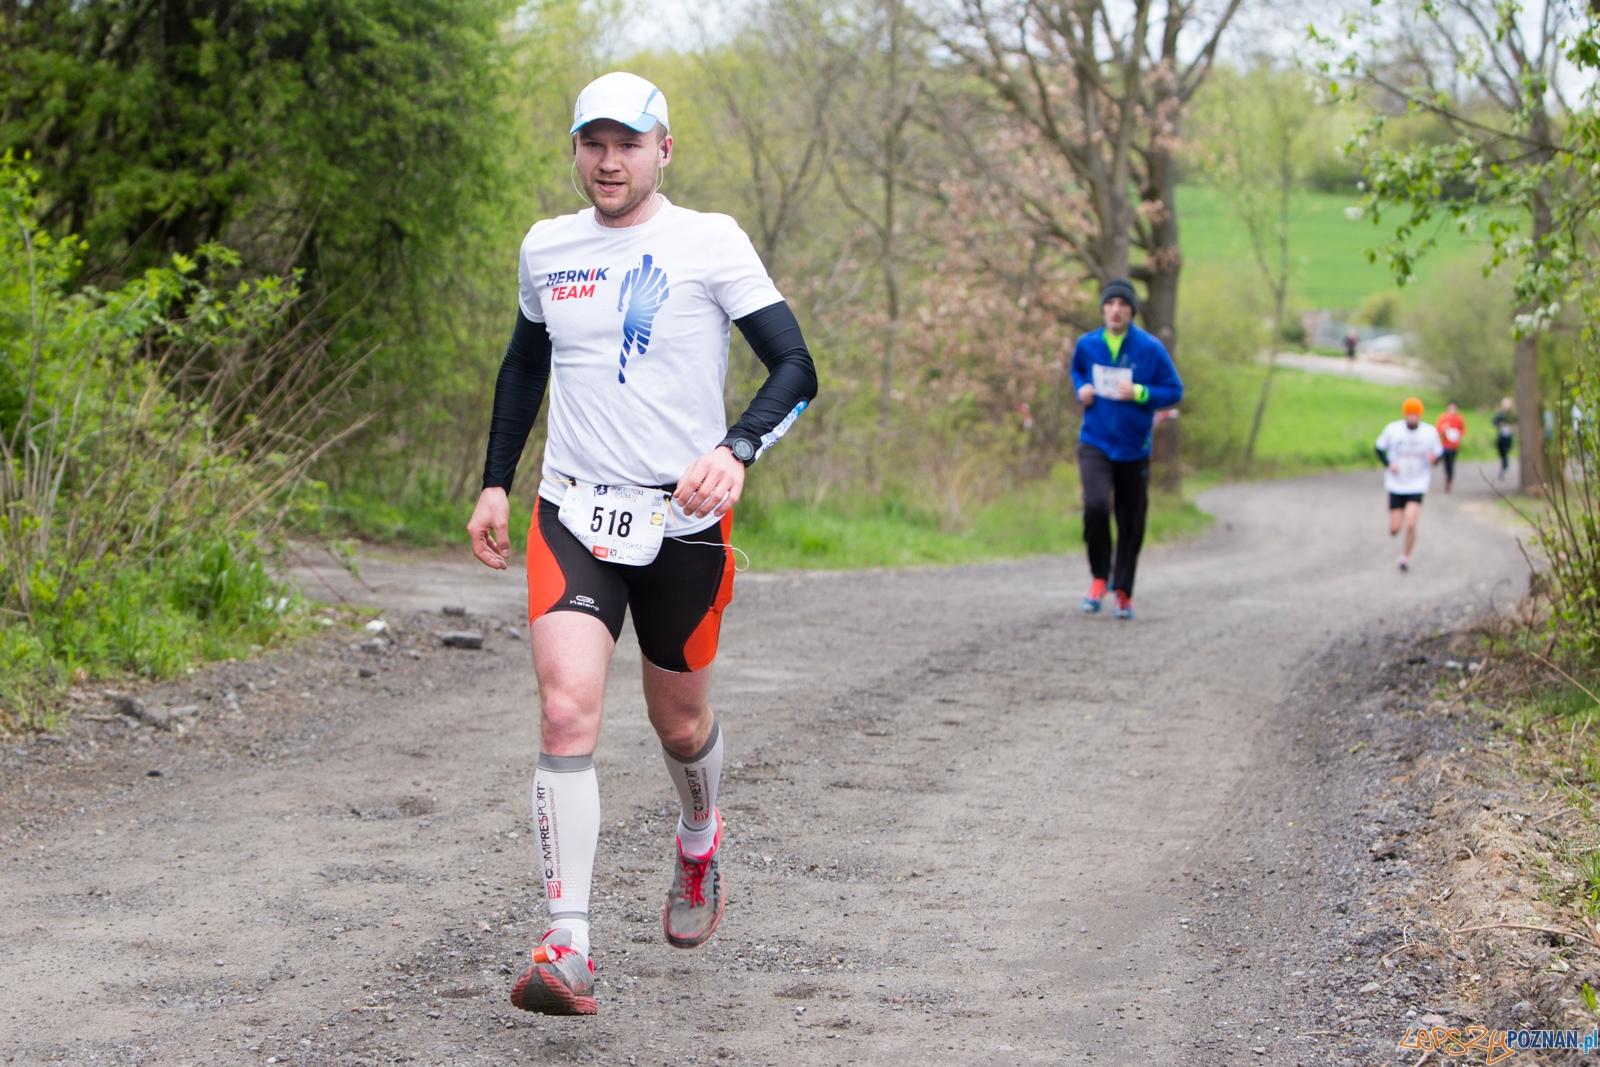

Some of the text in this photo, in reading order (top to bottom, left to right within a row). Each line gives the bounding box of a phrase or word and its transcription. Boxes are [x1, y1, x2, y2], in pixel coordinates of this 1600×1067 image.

[546, 267, 610, 286] HERNIK
[551, 284, 596, 302] TEAM
[590, 506, 633, 538] 518
[621, 541, 643, 550] 10KM
